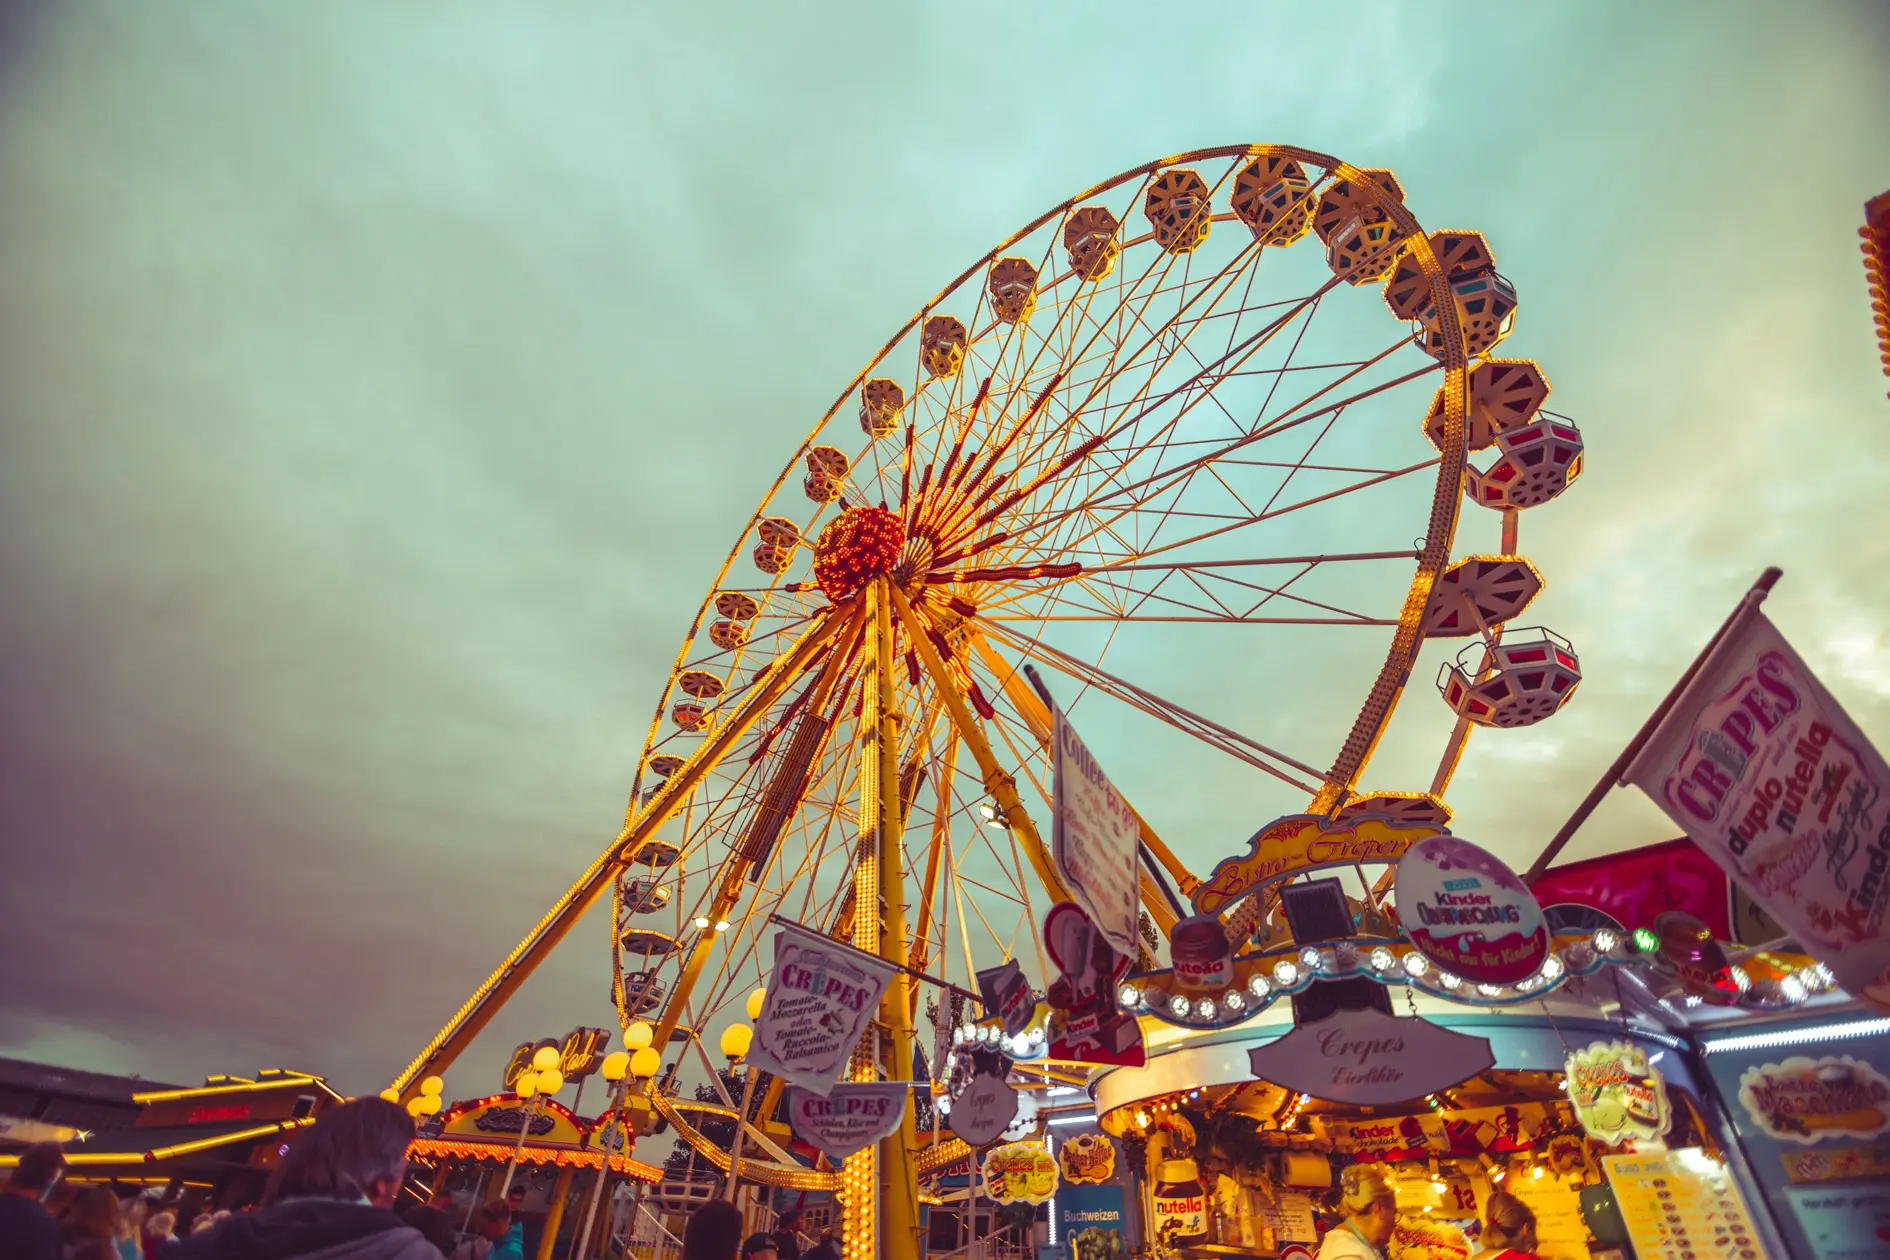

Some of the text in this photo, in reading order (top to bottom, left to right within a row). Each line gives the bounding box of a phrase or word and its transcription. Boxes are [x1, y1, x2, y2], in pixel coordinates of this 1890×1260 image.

[1775, 720, 1833, 834] nutella
[1729, 777, 1783, 856] duplo
[769, 1001, 827, 1021] Mozzarella
[784, 1042, 840, 1061] Balsamico
[1064, 1208, 1119, 1223] Buchweizen
[1157, 1197, 1202, 1215] nutella
